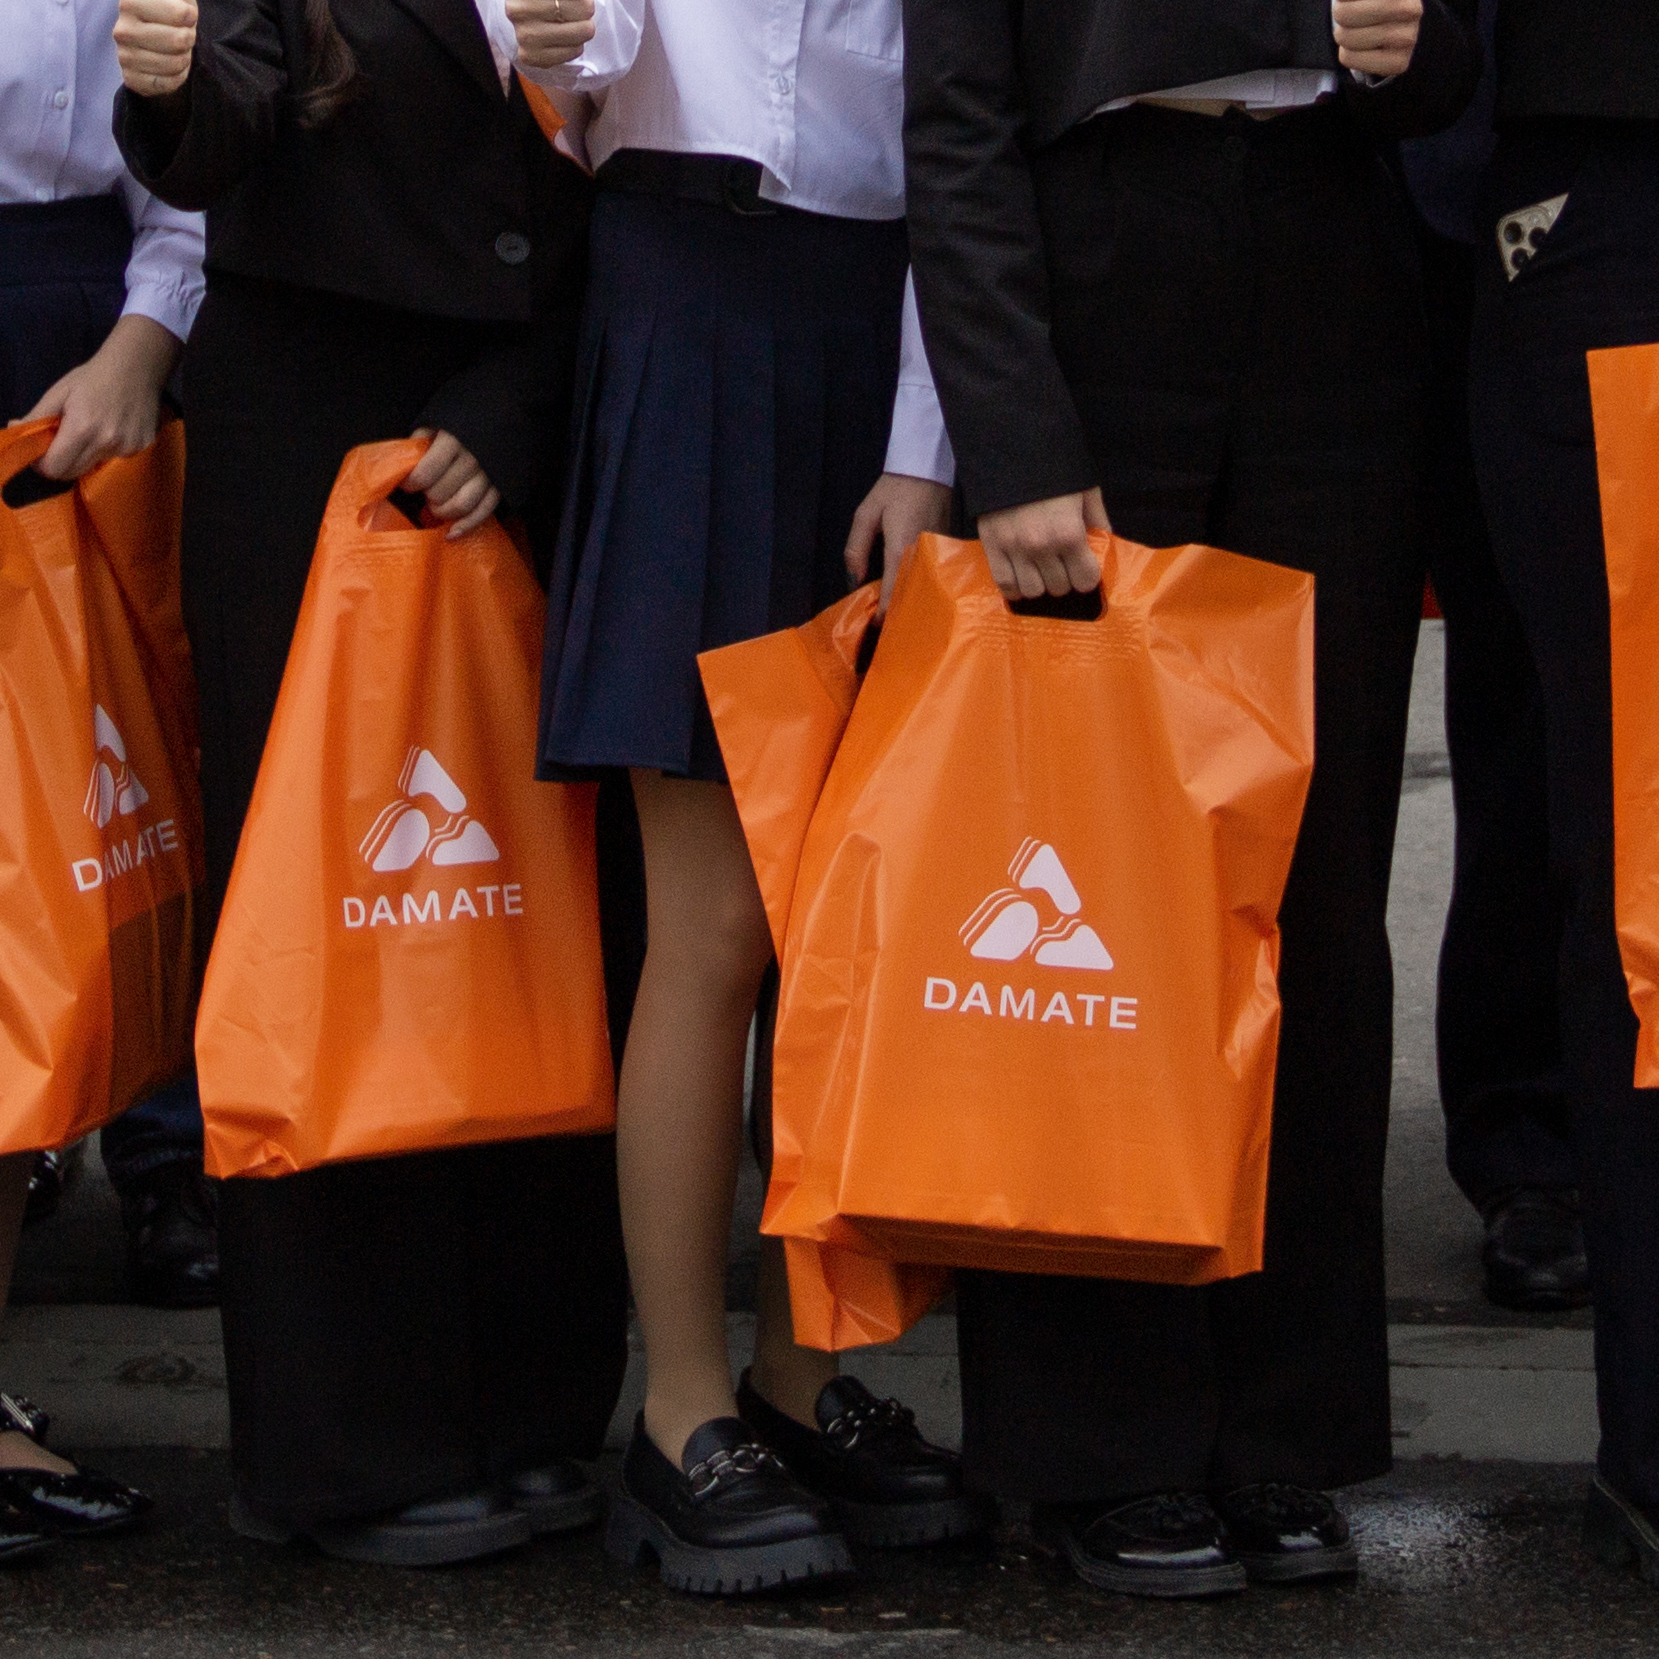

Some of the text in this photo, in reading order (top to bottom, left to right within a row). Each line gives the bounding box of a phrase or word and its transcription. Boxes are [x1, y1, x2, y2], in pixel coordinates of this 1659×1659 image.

[72, 819, 179, 892] DAMATE
[343, 885, 523, 928] DAMATE
[924, 976, 1139, 1030] DAMATE
